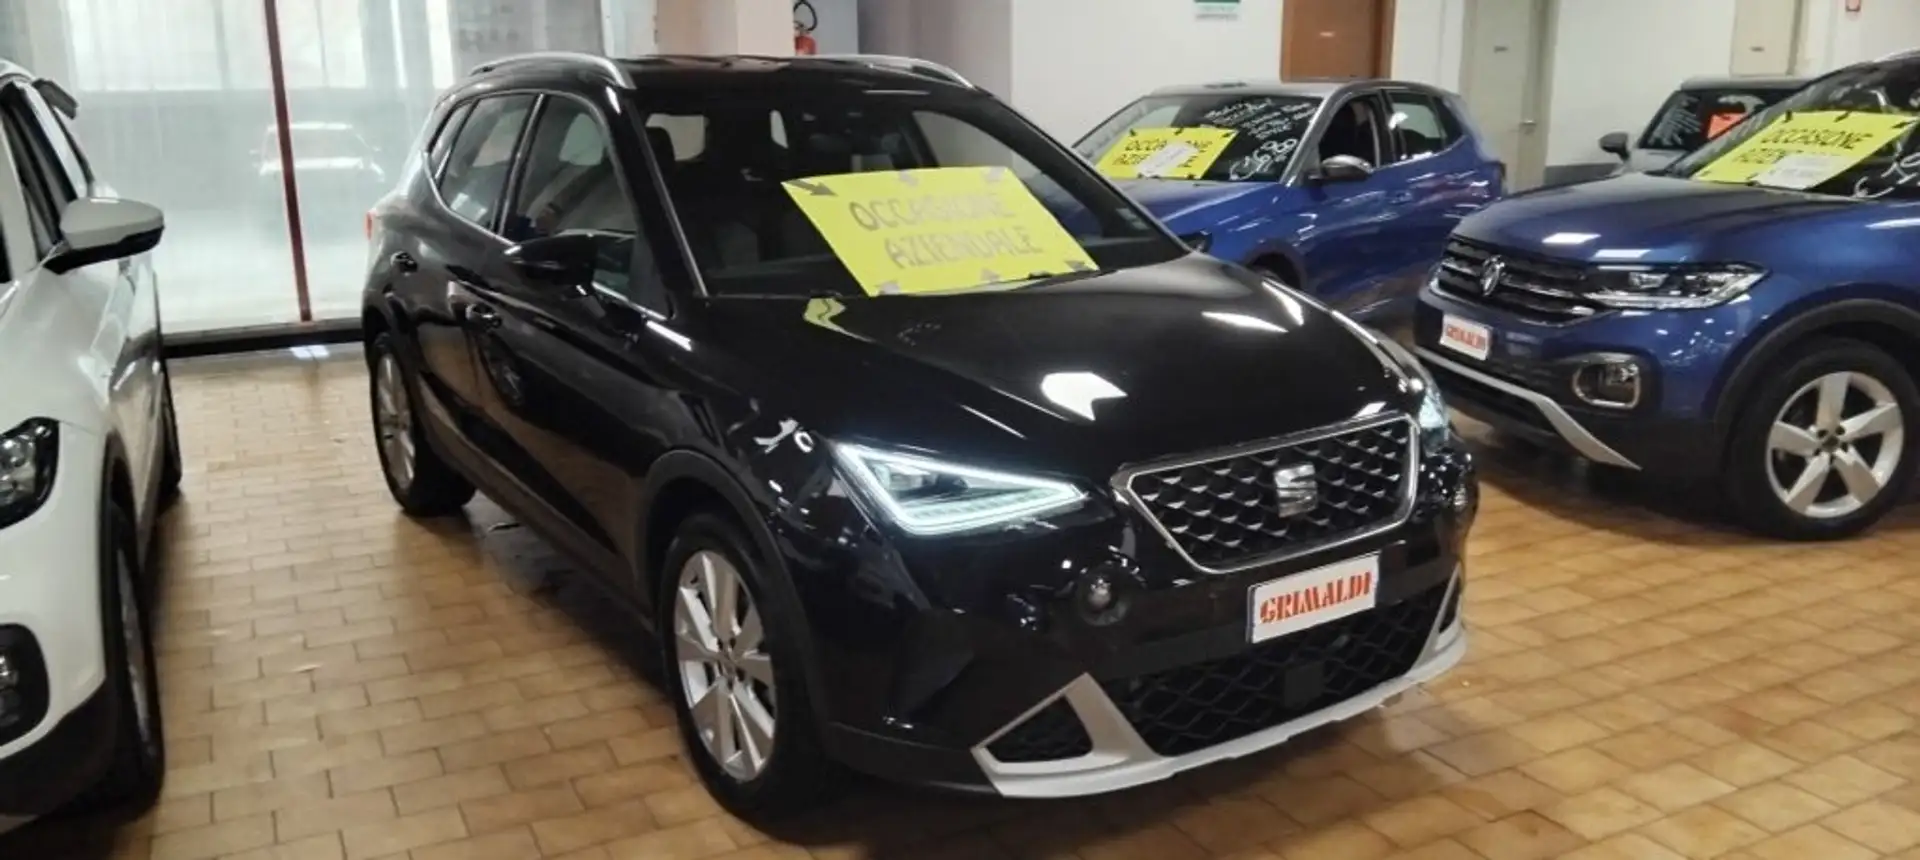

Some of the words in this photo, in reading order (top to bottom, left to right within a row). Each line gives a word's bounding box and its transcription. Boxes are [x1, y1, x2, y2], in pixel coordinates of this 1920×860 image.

[849, 192, 1017, 231] OCCASIONE
[883, 225, 1043, 270] AZIENDALE
[1259, 570, 1373, 624] GRIMALDI
